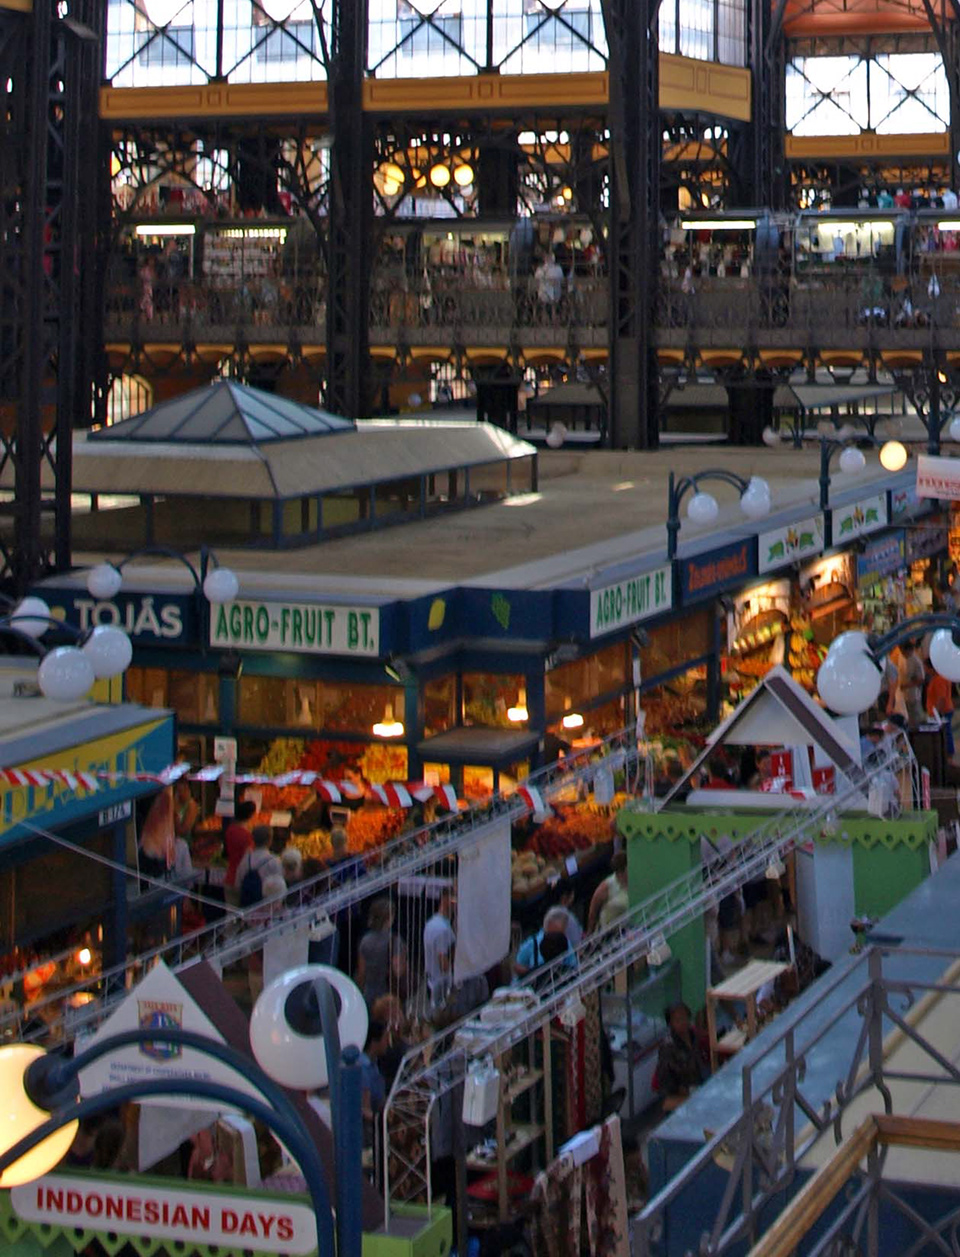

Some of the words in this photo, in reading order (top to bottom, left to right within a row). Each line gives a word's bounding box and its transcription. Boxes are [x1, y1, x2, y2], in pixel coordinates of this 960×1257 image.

[215, 603, 336, 647] AGRO-FRUIT
[597, 575, 651, 628] AGRO-FRUIT
[36, 1185, 210, 1230] INDONESIAN
[221, 1207, 294, 1242] DAYS
